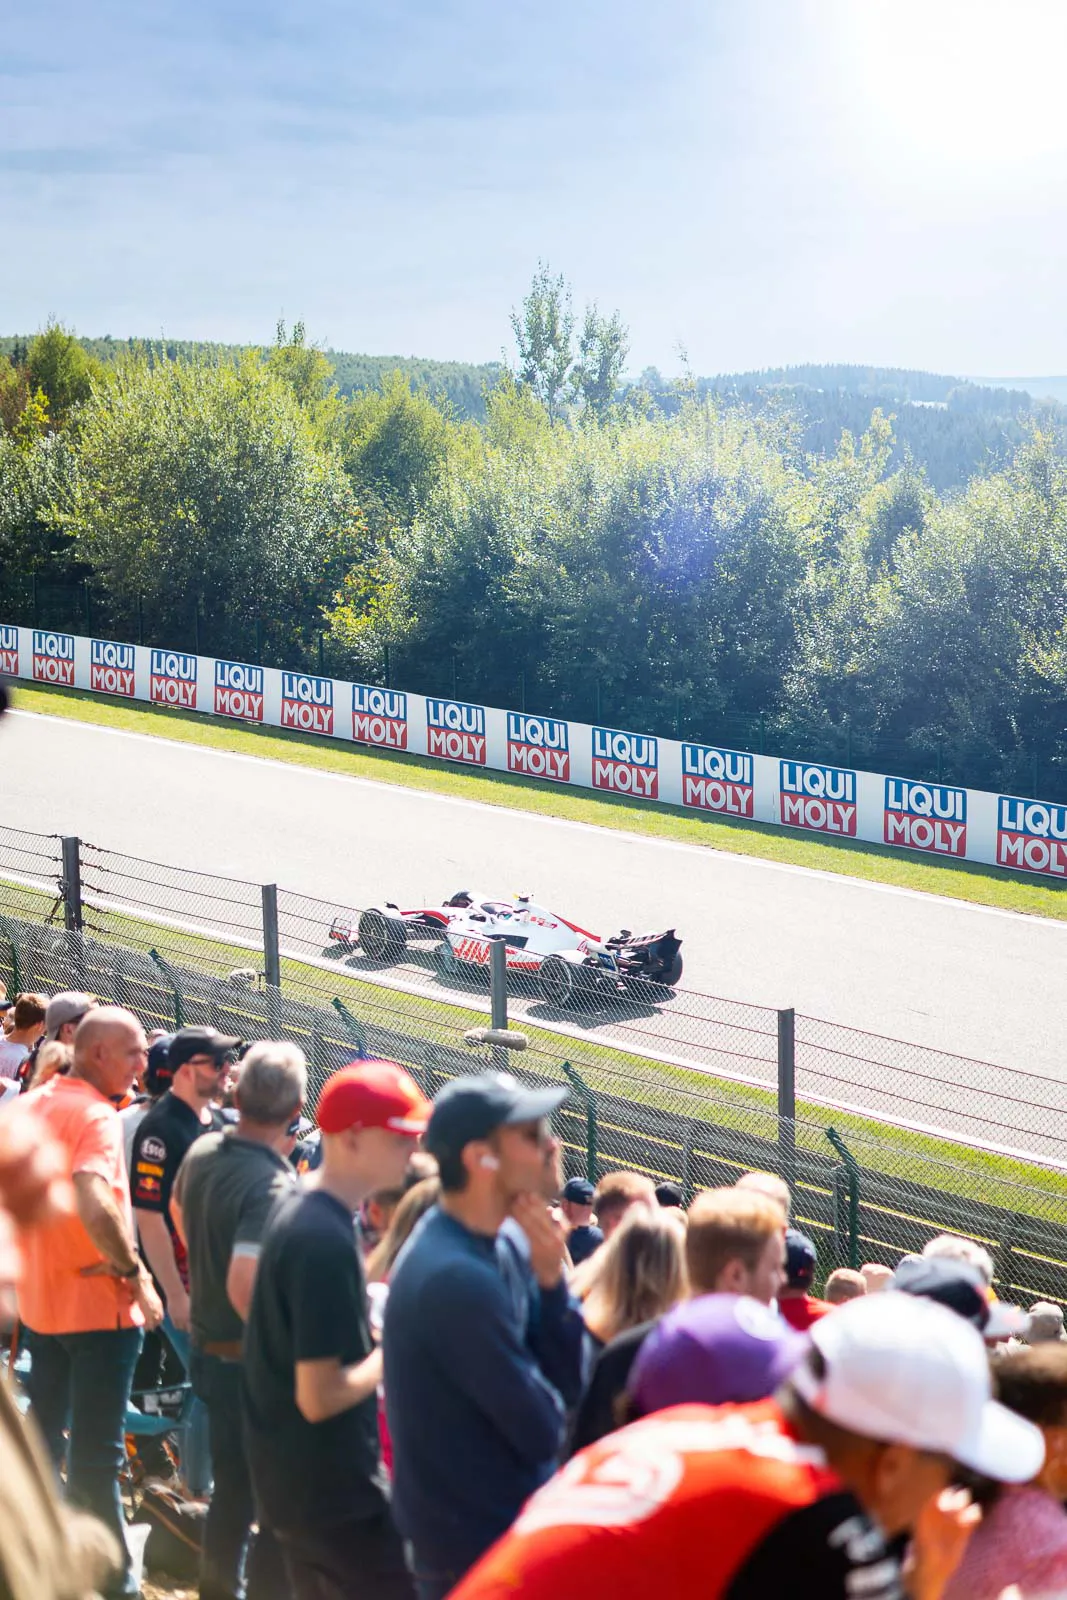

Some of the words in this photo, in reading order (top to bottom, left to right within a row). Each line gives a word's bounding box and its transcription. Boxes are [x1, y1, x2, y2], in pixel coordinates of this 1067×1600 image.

[35, 634, 72, 659] LIQUI
[93, 643, 132, 669] LIQUI
[35, 659, 73, 682] MOLY
[93, 668, 133, 692] MOLY
[153, 653, 195, 679] LIQUI
[218, 664, 261, 692] LIQUI
[152, 679, 195, 705] MOLY
[217, 690, 262, 717] MOLY
[285, 675, 330, 704] LIQUI
[355, 686, 404, 718] LIQUI
[283, 703, 332, 731] MOLY
[354, 716, 406, 746] MOLY
[429, 702, 482, 733] LIQUI
[510, 715, 565, 749] LIQUI
[431, 730, 484, 761] MOLY
[595, 730, 654, 766] LIQUI
[511, 746, 568, 778] MOLY
[686, 747, 750, 783] LIQUI
[595, 761, 656, 796] MOLY
[784, 763, 852, 801] LIQUI
[687, 778, 752, 815] MOLY
[889, 780, 963, 820] LIQUI
[784, 796, 854, 833] MOLY
[888, 813, 965, 853] MOLY
